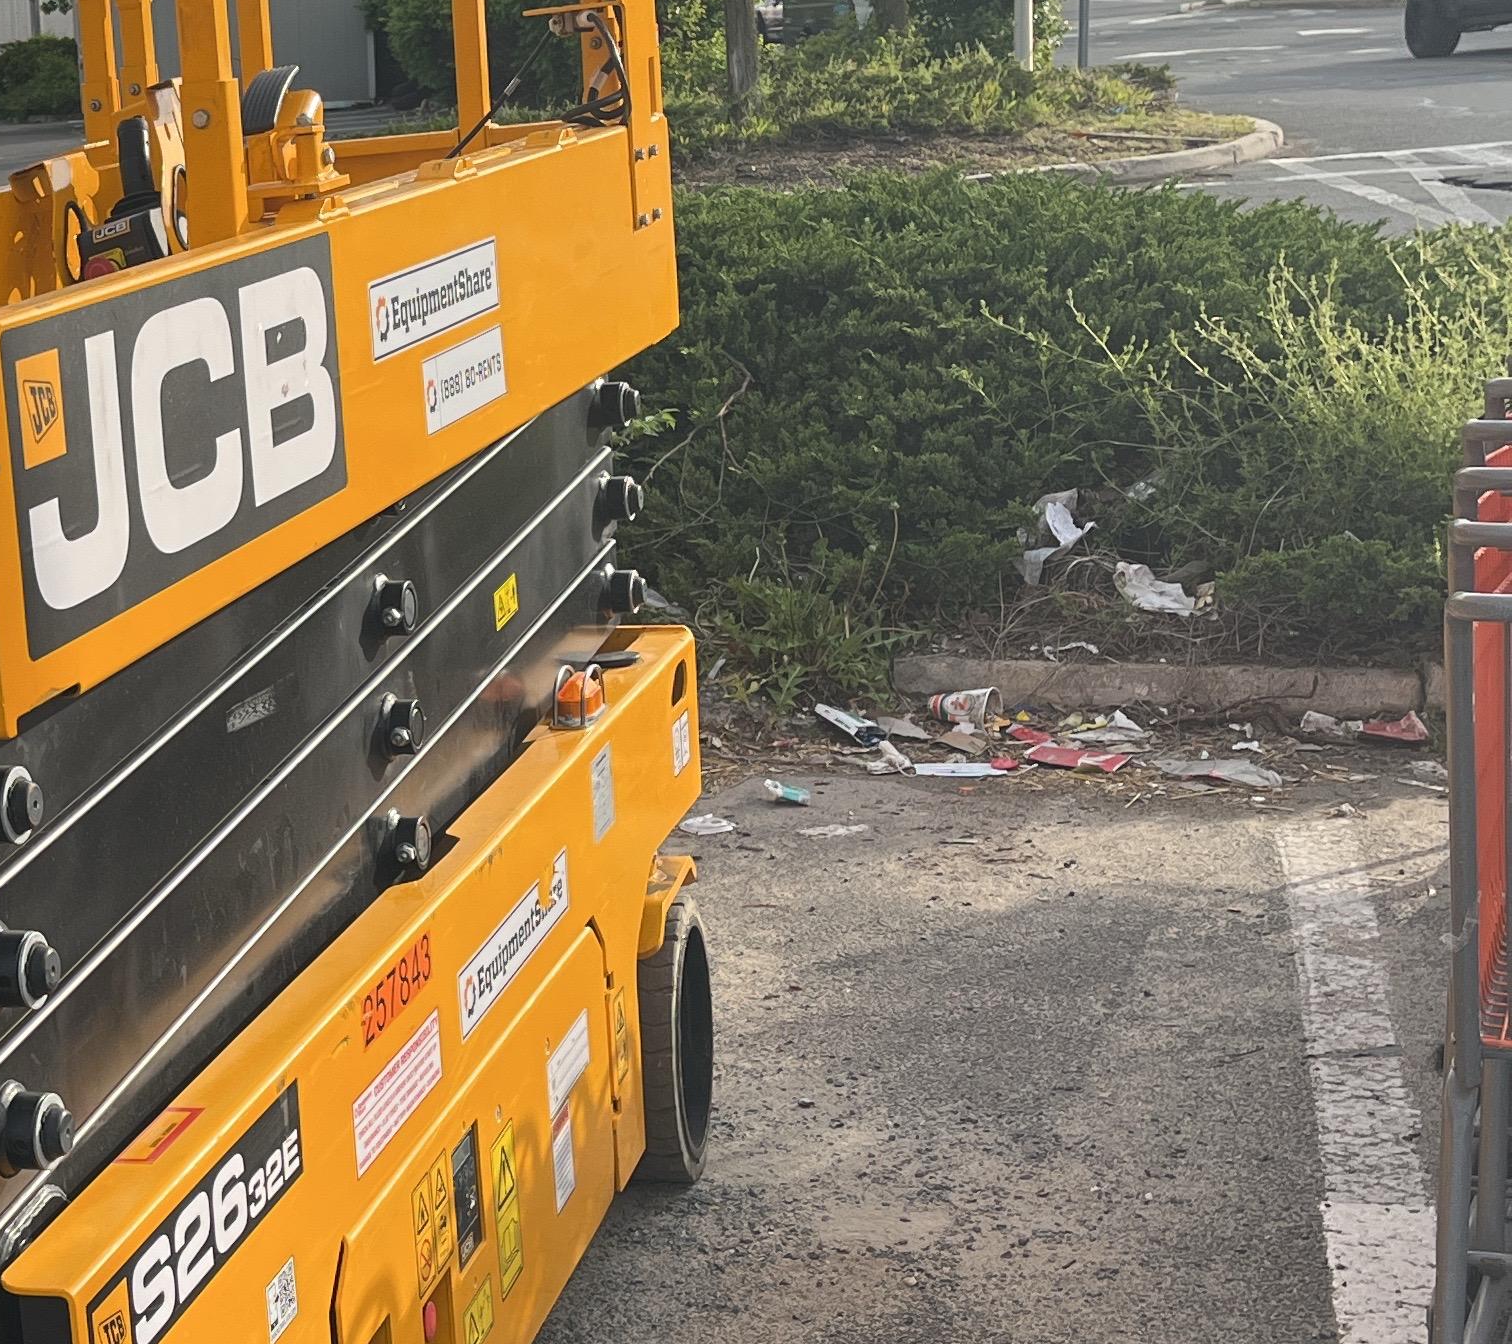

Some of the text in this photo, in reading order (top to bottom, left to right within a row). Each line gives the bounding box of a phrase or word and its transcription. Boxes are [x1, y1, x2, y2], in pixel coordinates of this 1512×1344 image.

[95, 221, 127, 239] JCB
[390, 266, 493, 333] EquipmentShare
[28, 265, 338, 611] JCB
[29, 385, 57, 436] JCB
[361, 932, 432, 1049] 257843
